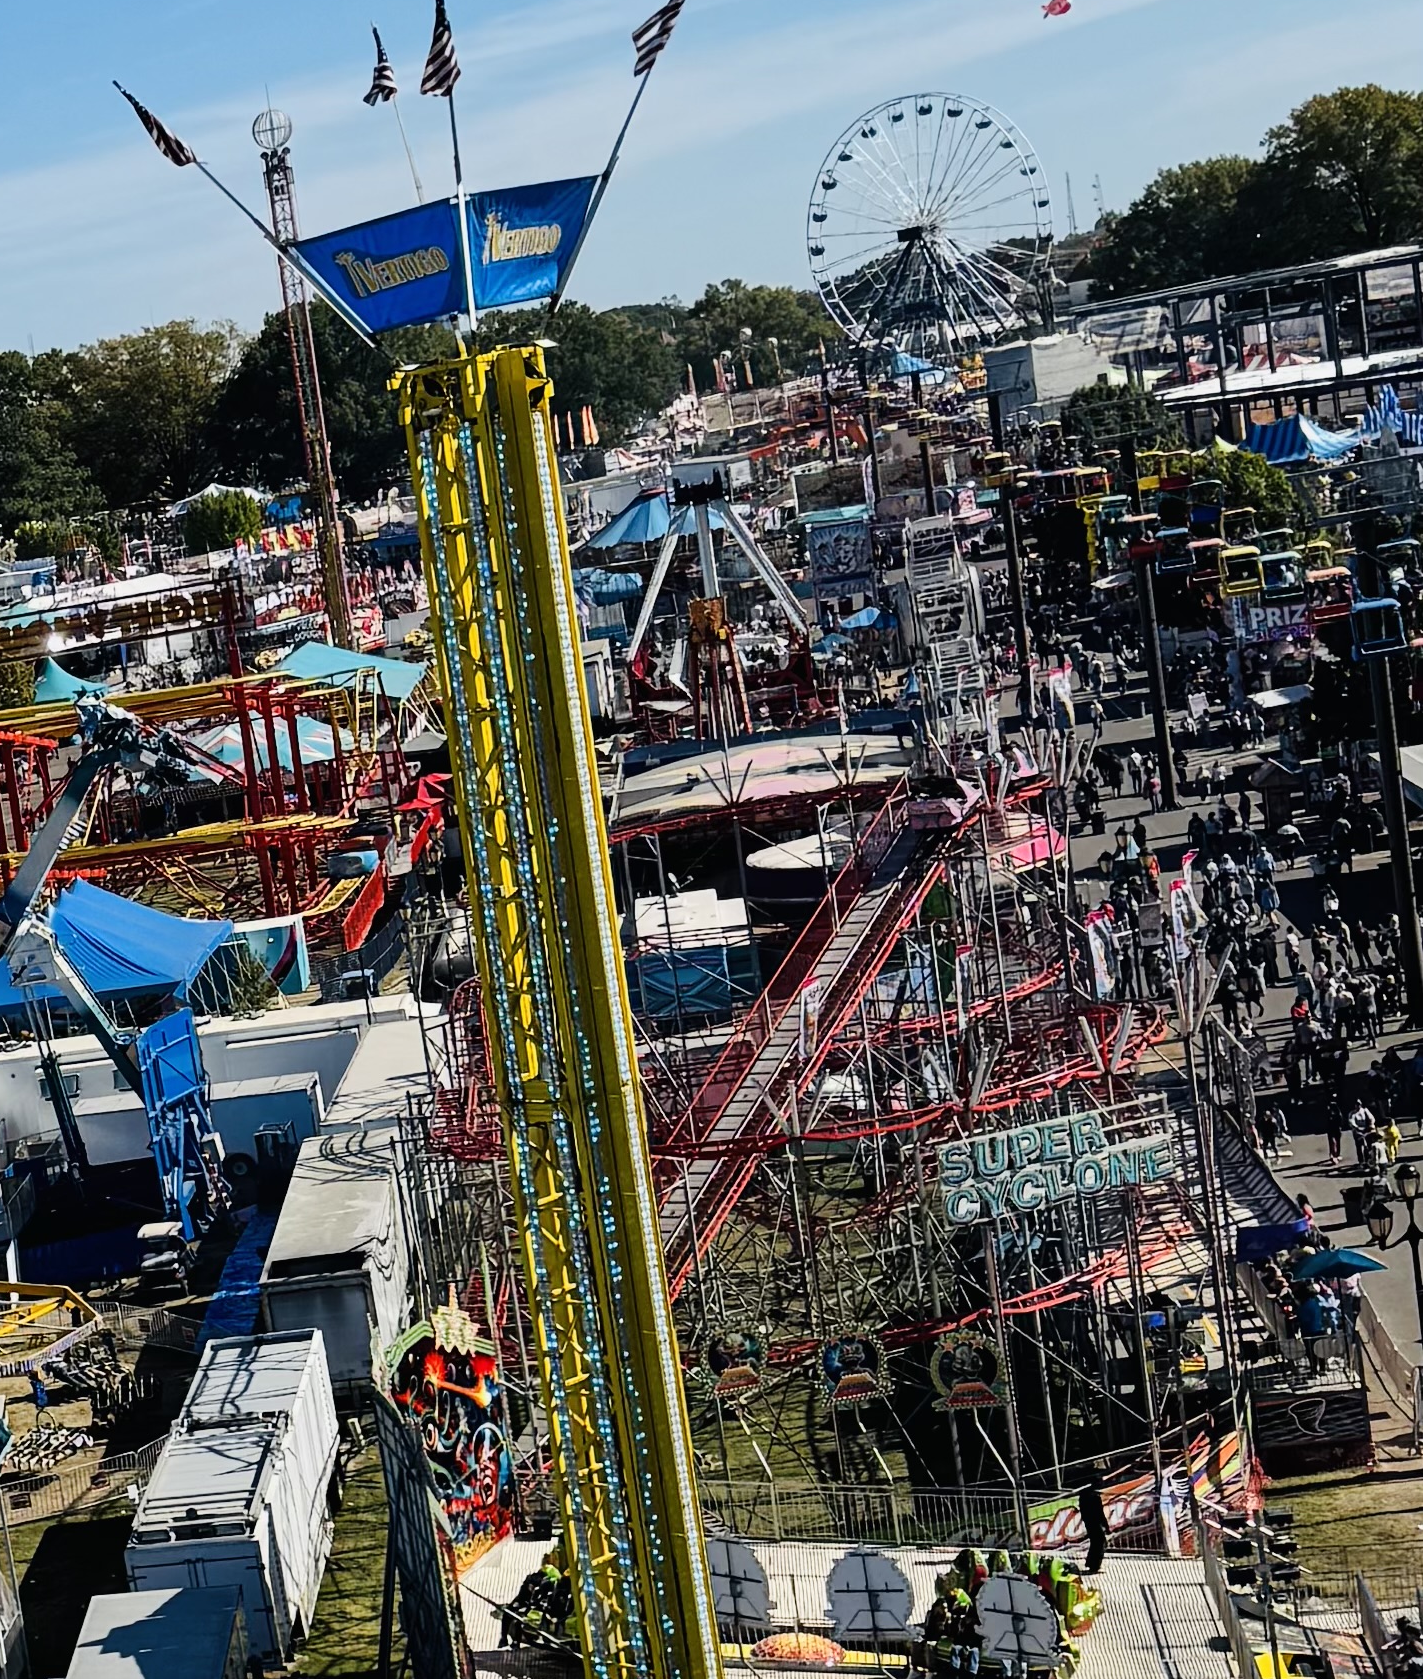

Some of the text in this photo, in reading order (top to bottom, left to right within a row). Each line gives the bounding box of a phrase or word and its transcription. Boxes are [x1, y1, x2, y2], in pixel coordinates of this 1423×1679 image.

[354, 246, 449, 294] VERTIGO
[491, 222, 562, 263] VERTIGO
[940, 1111, 1108, 1188] SUPER
[943, 1138, 1176, 1226] CYCLONE
